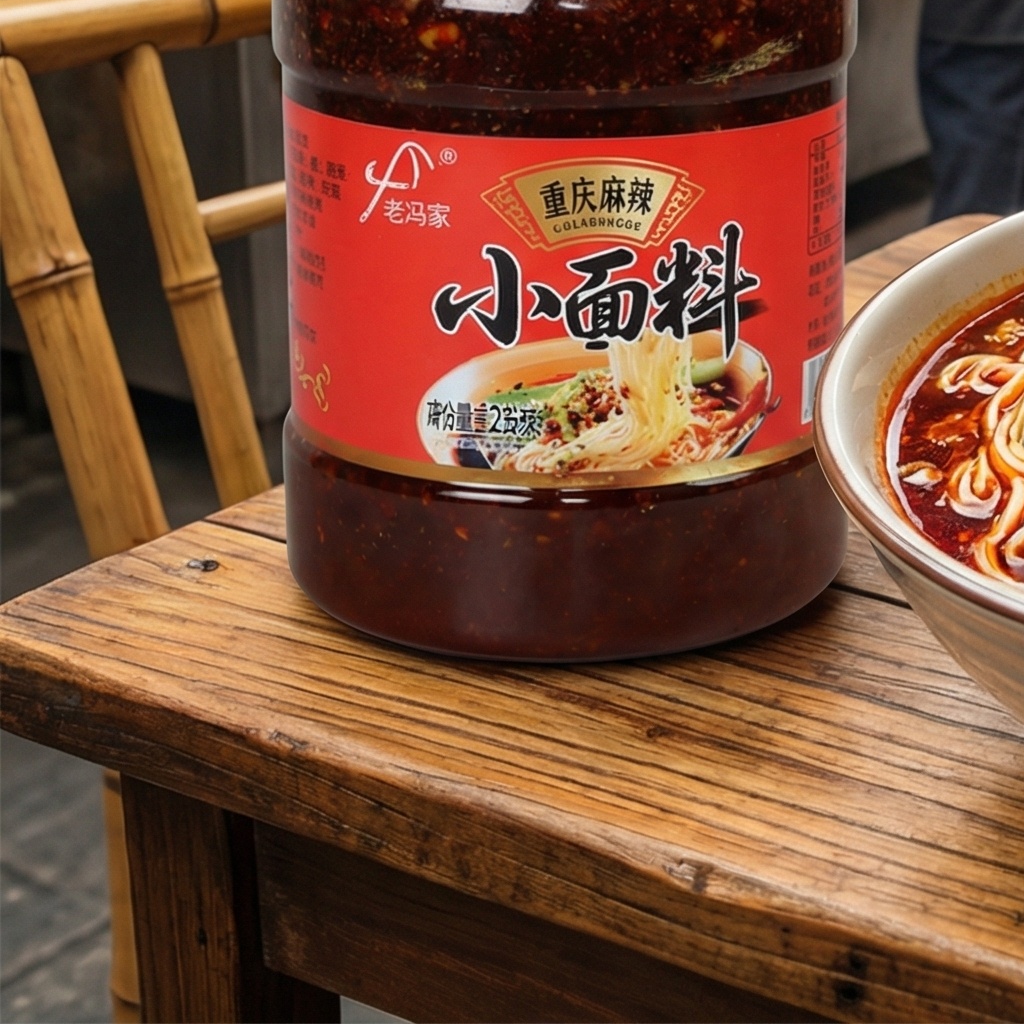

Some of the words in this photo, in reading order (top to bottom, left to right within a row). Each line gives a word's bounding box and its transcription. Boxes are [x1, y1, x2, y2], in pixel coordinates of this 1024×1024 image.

[383, 198, 451, 229] 老冯家
[539, 175, 655, 220] 重庆麻辣
[432, 222, 760, 362] 小面料
